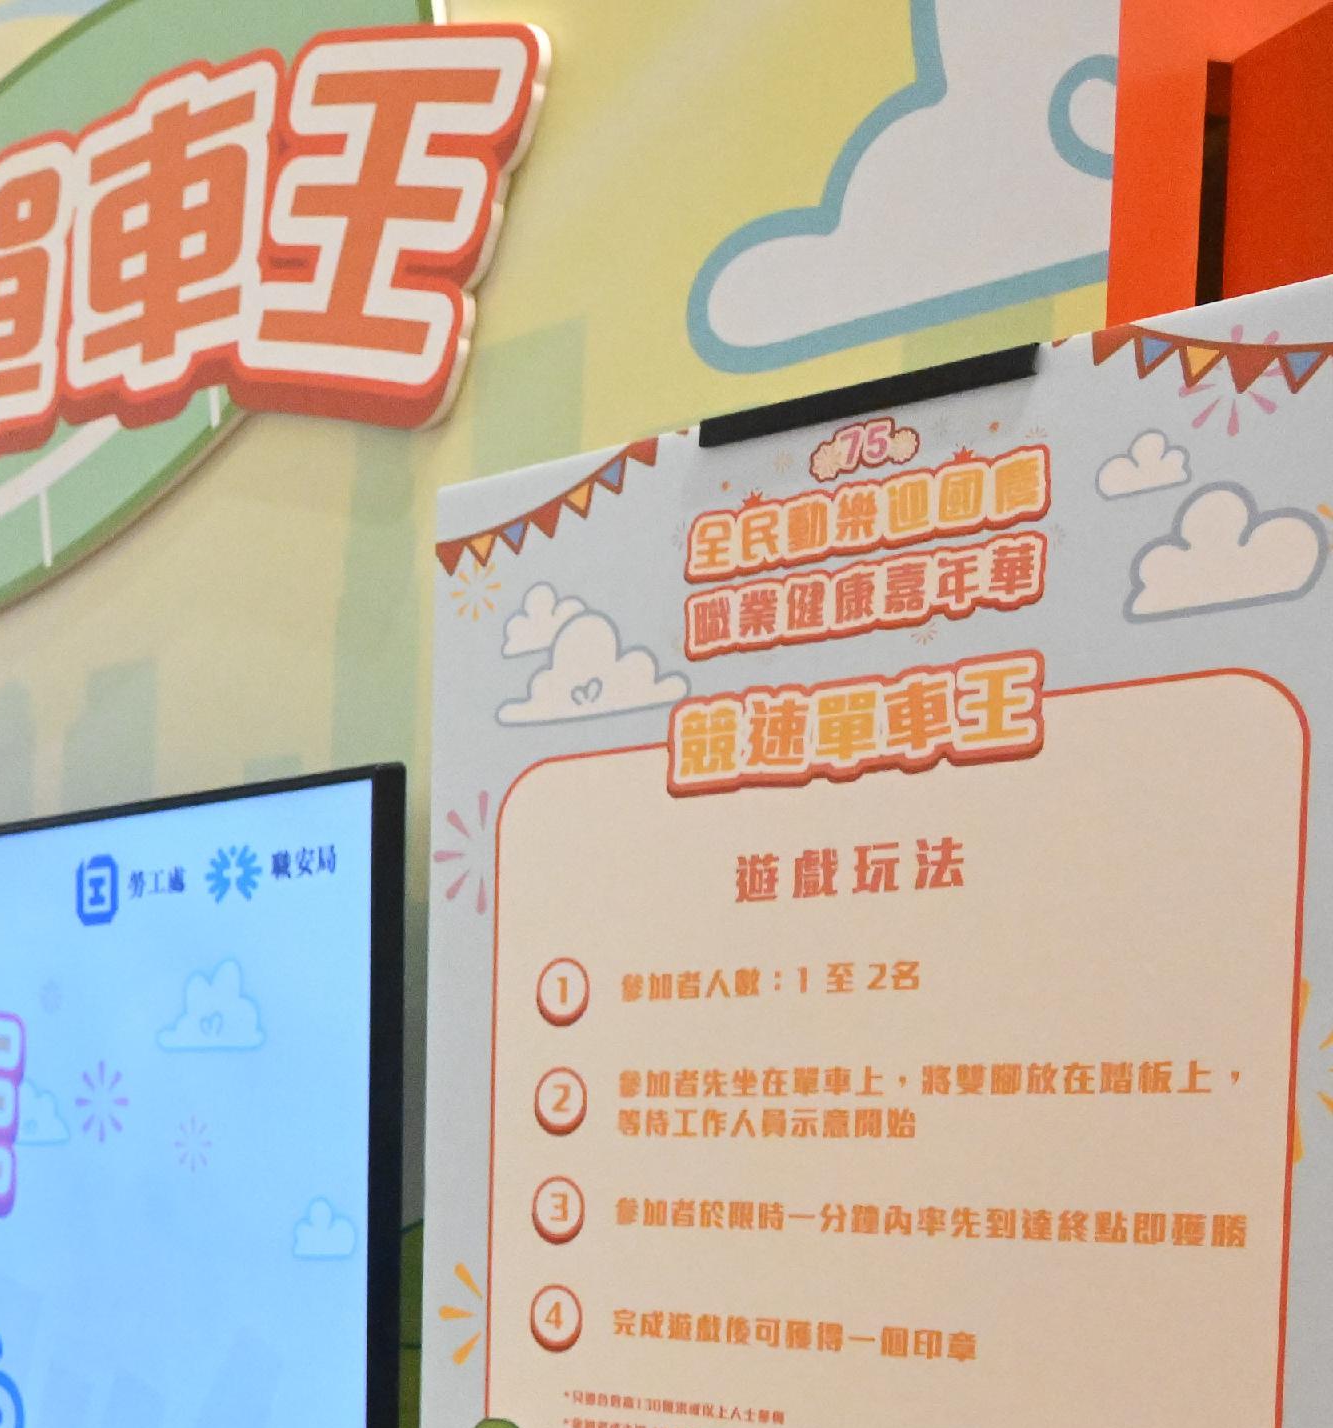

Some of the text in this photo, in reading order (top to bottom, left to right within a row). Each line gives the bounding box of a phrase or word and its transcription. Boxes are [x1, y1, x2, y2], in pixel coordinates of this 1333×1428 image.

[840, 424, 890, 465] 75
[694, 456, 1041, 570] 全民動樂迎國慶
[693, 543, 1037, 648] 職業健康嘉年華
[679, 664, 1031, 778] 競速單車王
[270, 843, 337, 881] 職安局
[734, 837, 966, 905] 遊戲玩法
[127, 865, 186, 900] 勞工處
[556, 975, 569, 1006] 1
[551, 1082, 572, 1113] 2
[617, 1107, 917, 1140] 等待工作人員示意開始
[549, 1192, 569, 1223] 3
[544, 1300, 978, 1363] 4 完成遊戲後可獲得一個印章
